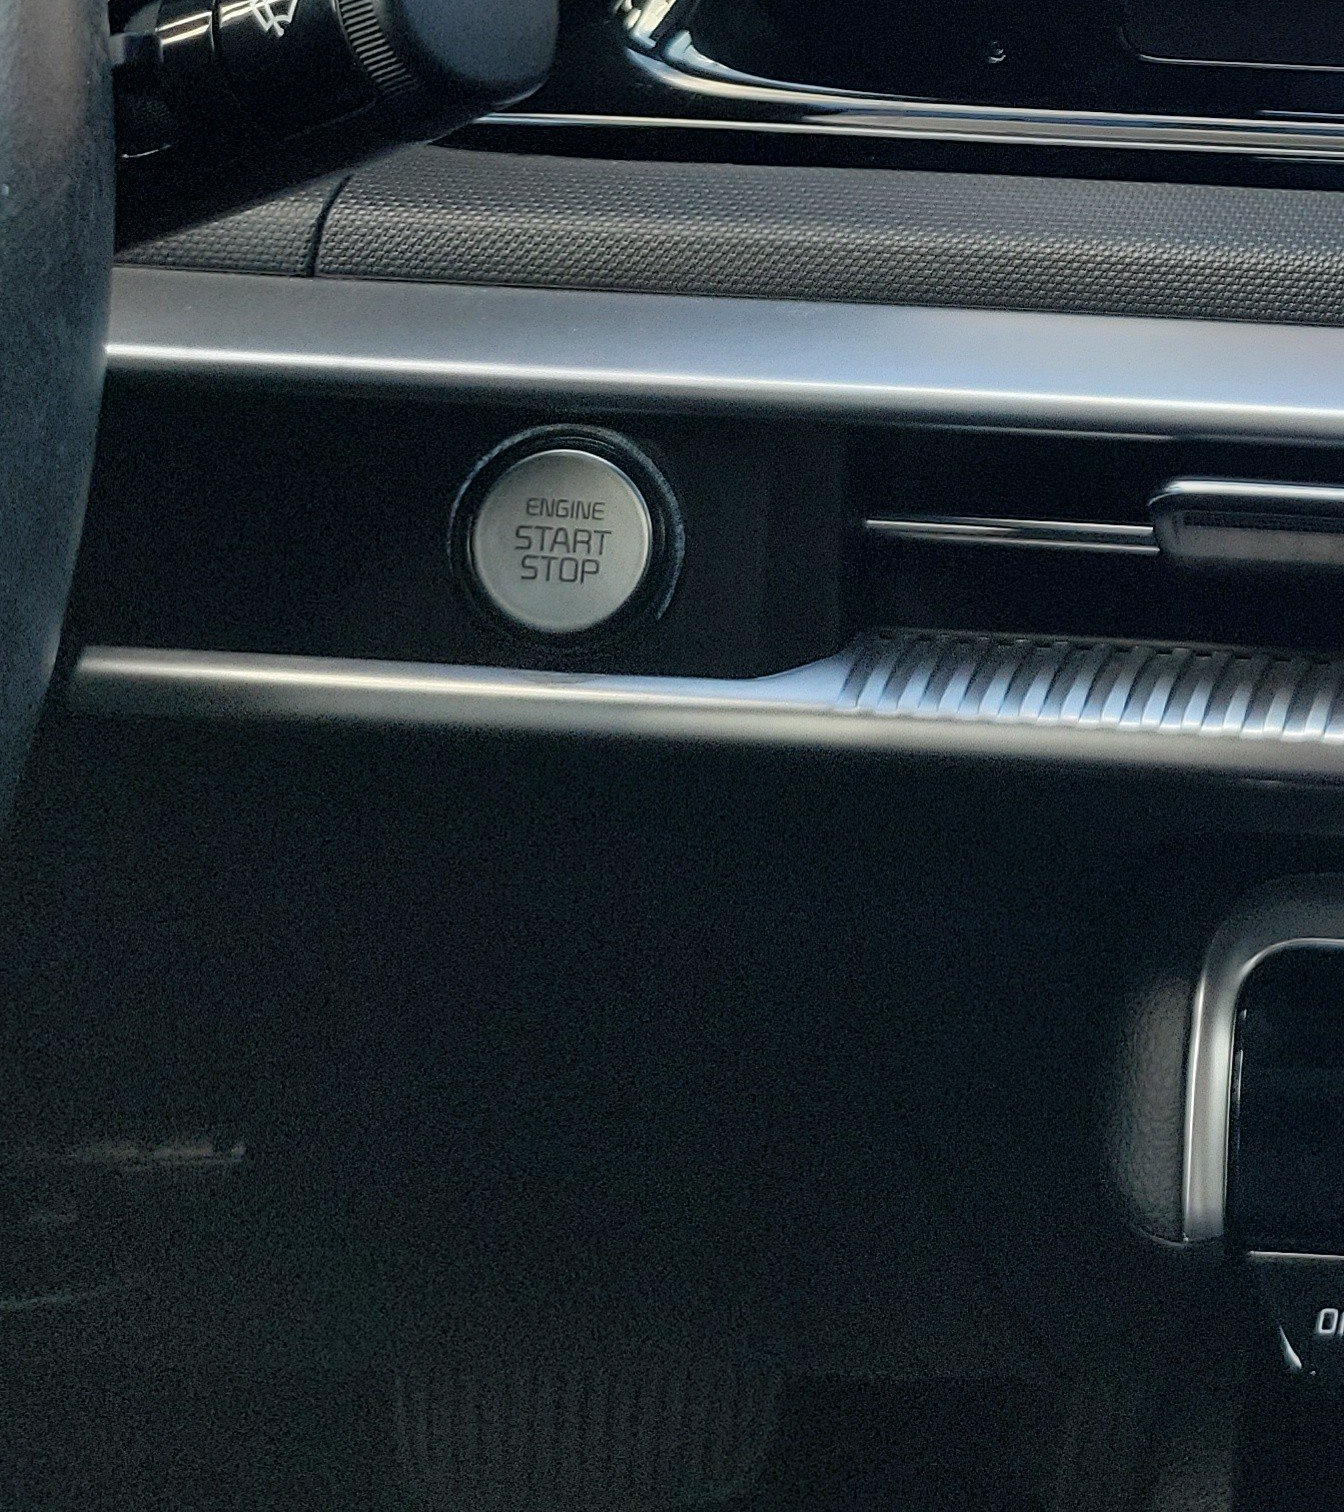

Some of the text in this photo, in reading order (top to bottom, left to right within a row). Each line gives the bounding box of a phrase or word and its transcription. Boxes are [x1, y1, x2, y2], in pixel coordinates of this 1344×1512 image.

[526, 497, 606, 520] ENGINE
[514, 524, 612, 556] START
[520, 554, 601, 584] STOP
